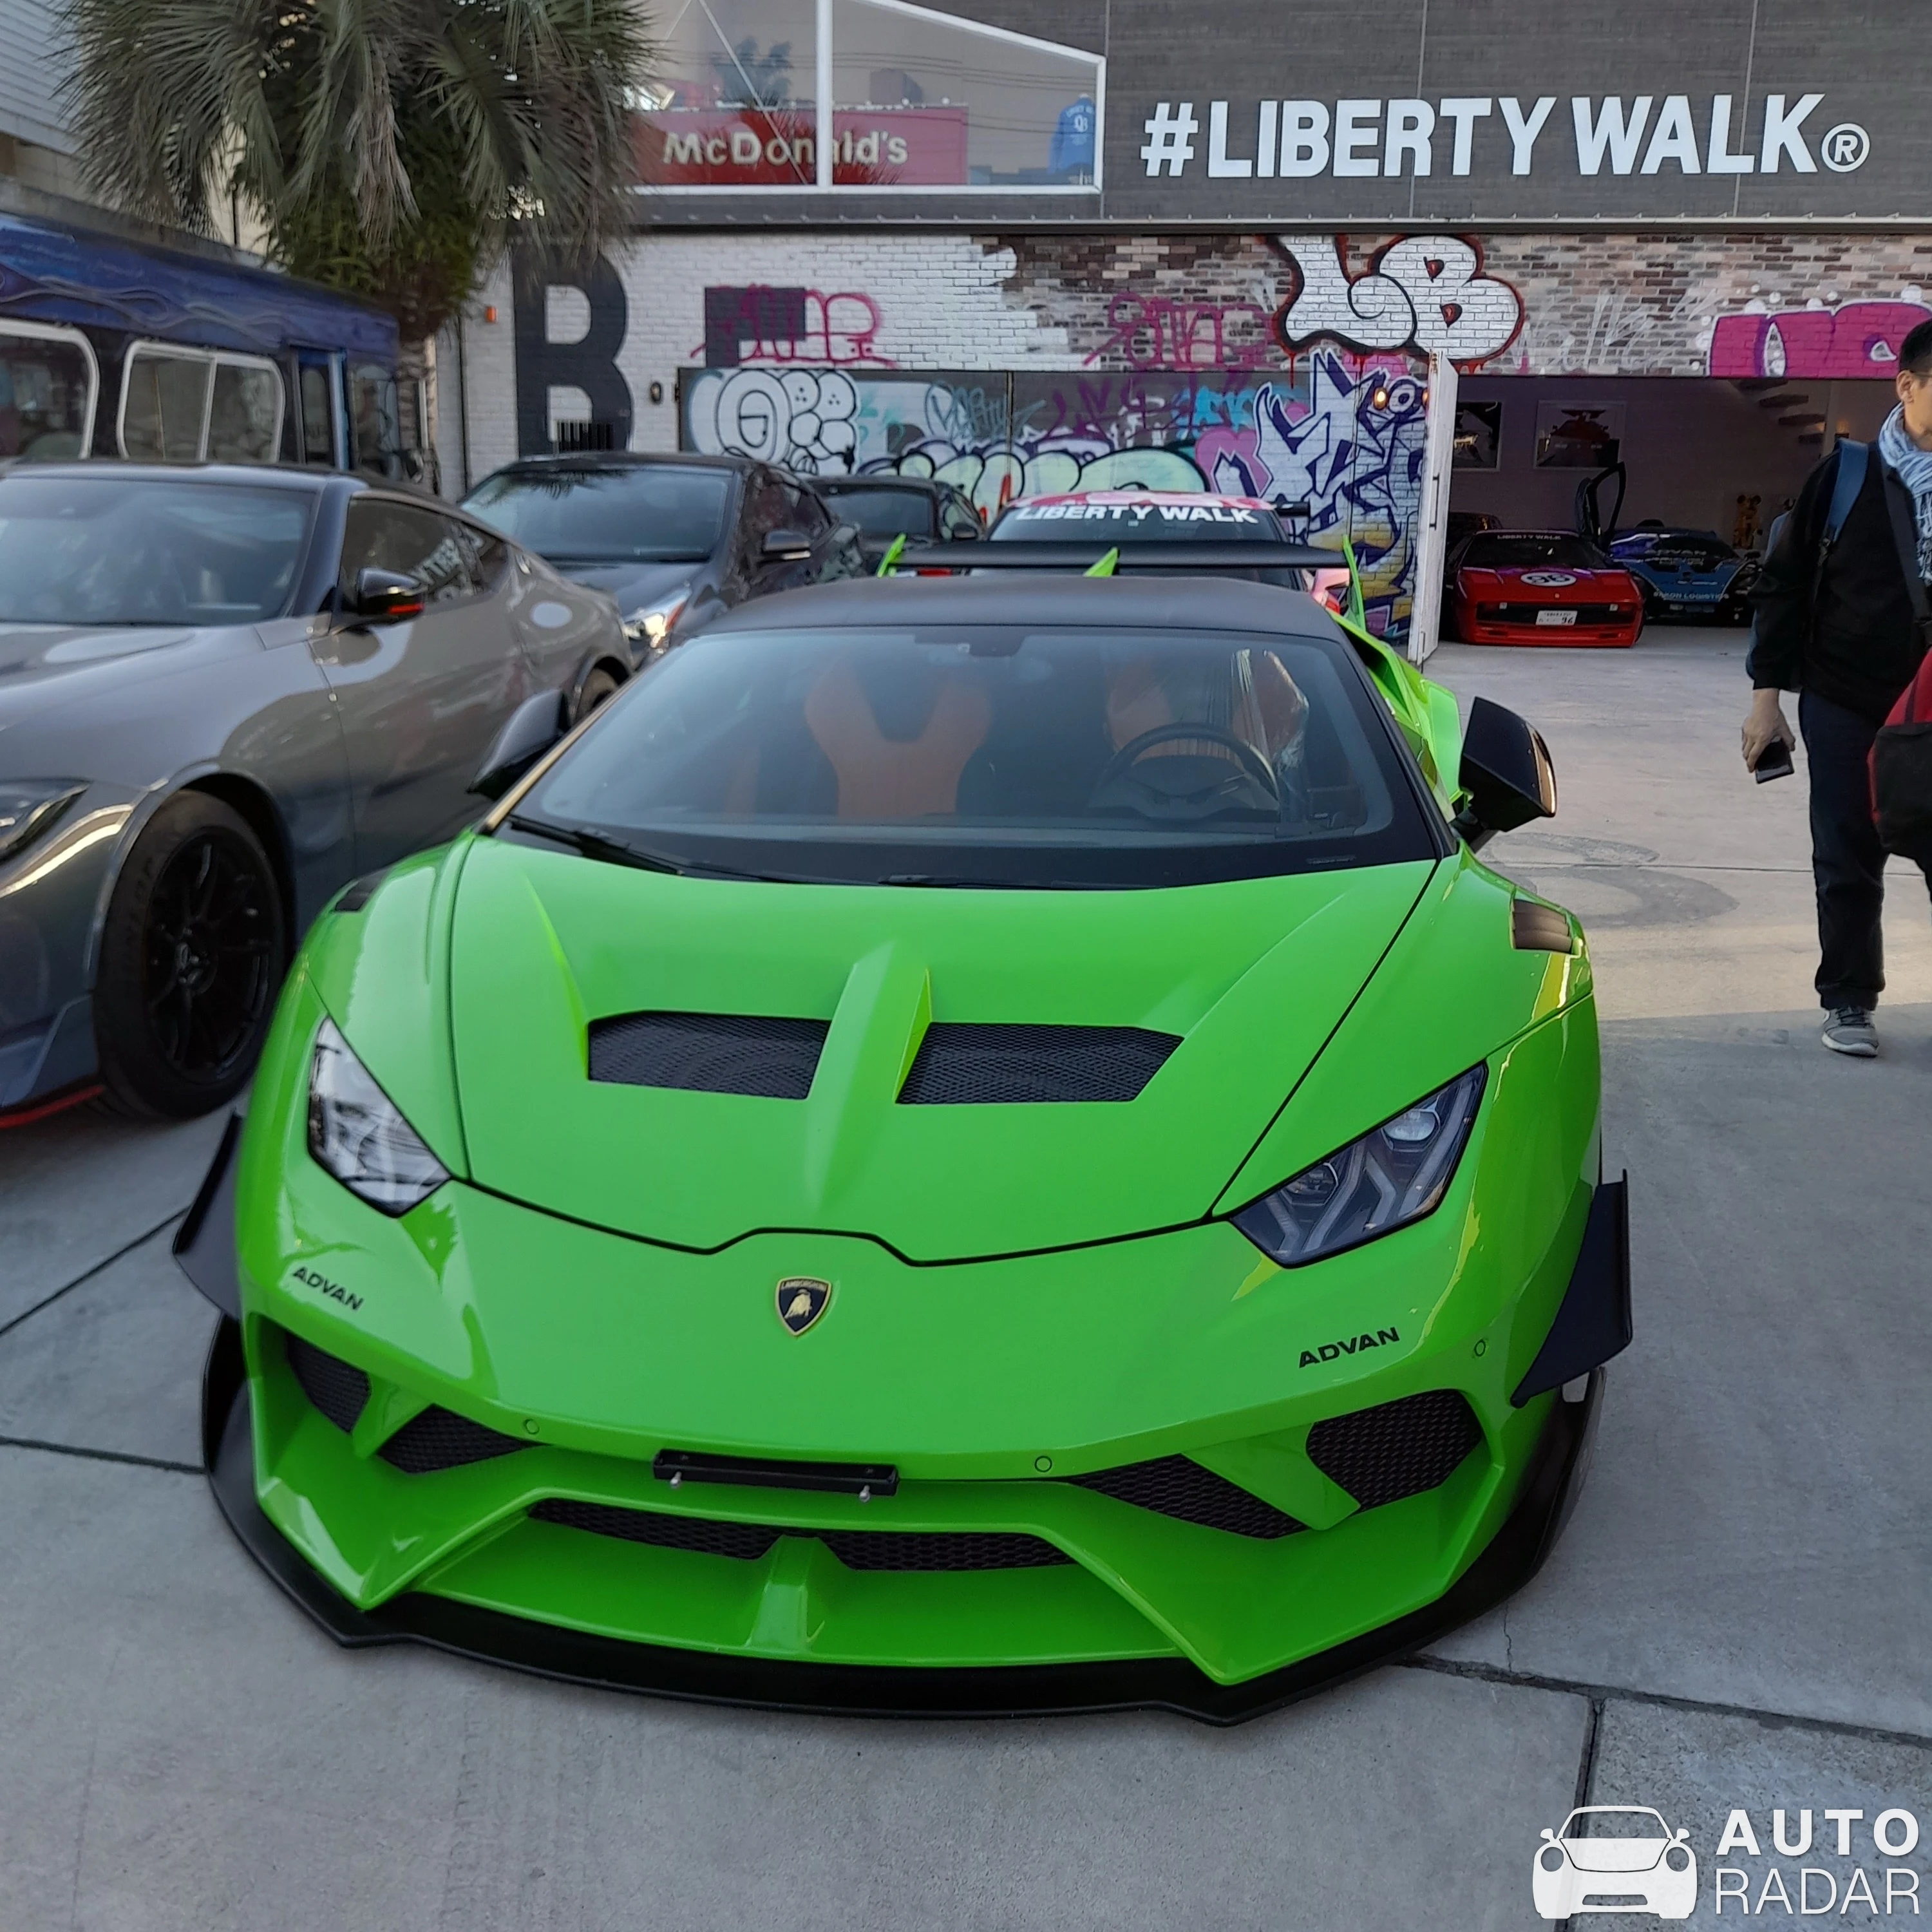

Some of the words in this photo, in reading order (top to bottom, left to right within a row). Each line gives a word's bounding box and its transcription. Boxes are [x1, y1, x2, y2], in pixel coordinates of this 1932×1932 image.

[1141, 98, 1557, 177] #LIBERTY
[1016, 504, 1154, 521] LIBERTY
[1159, 507, 1259, 524] WALK
[293, 1266, 364, 1311] ADVAN
[1298, 1326, 1400, 1368] ADVAN
